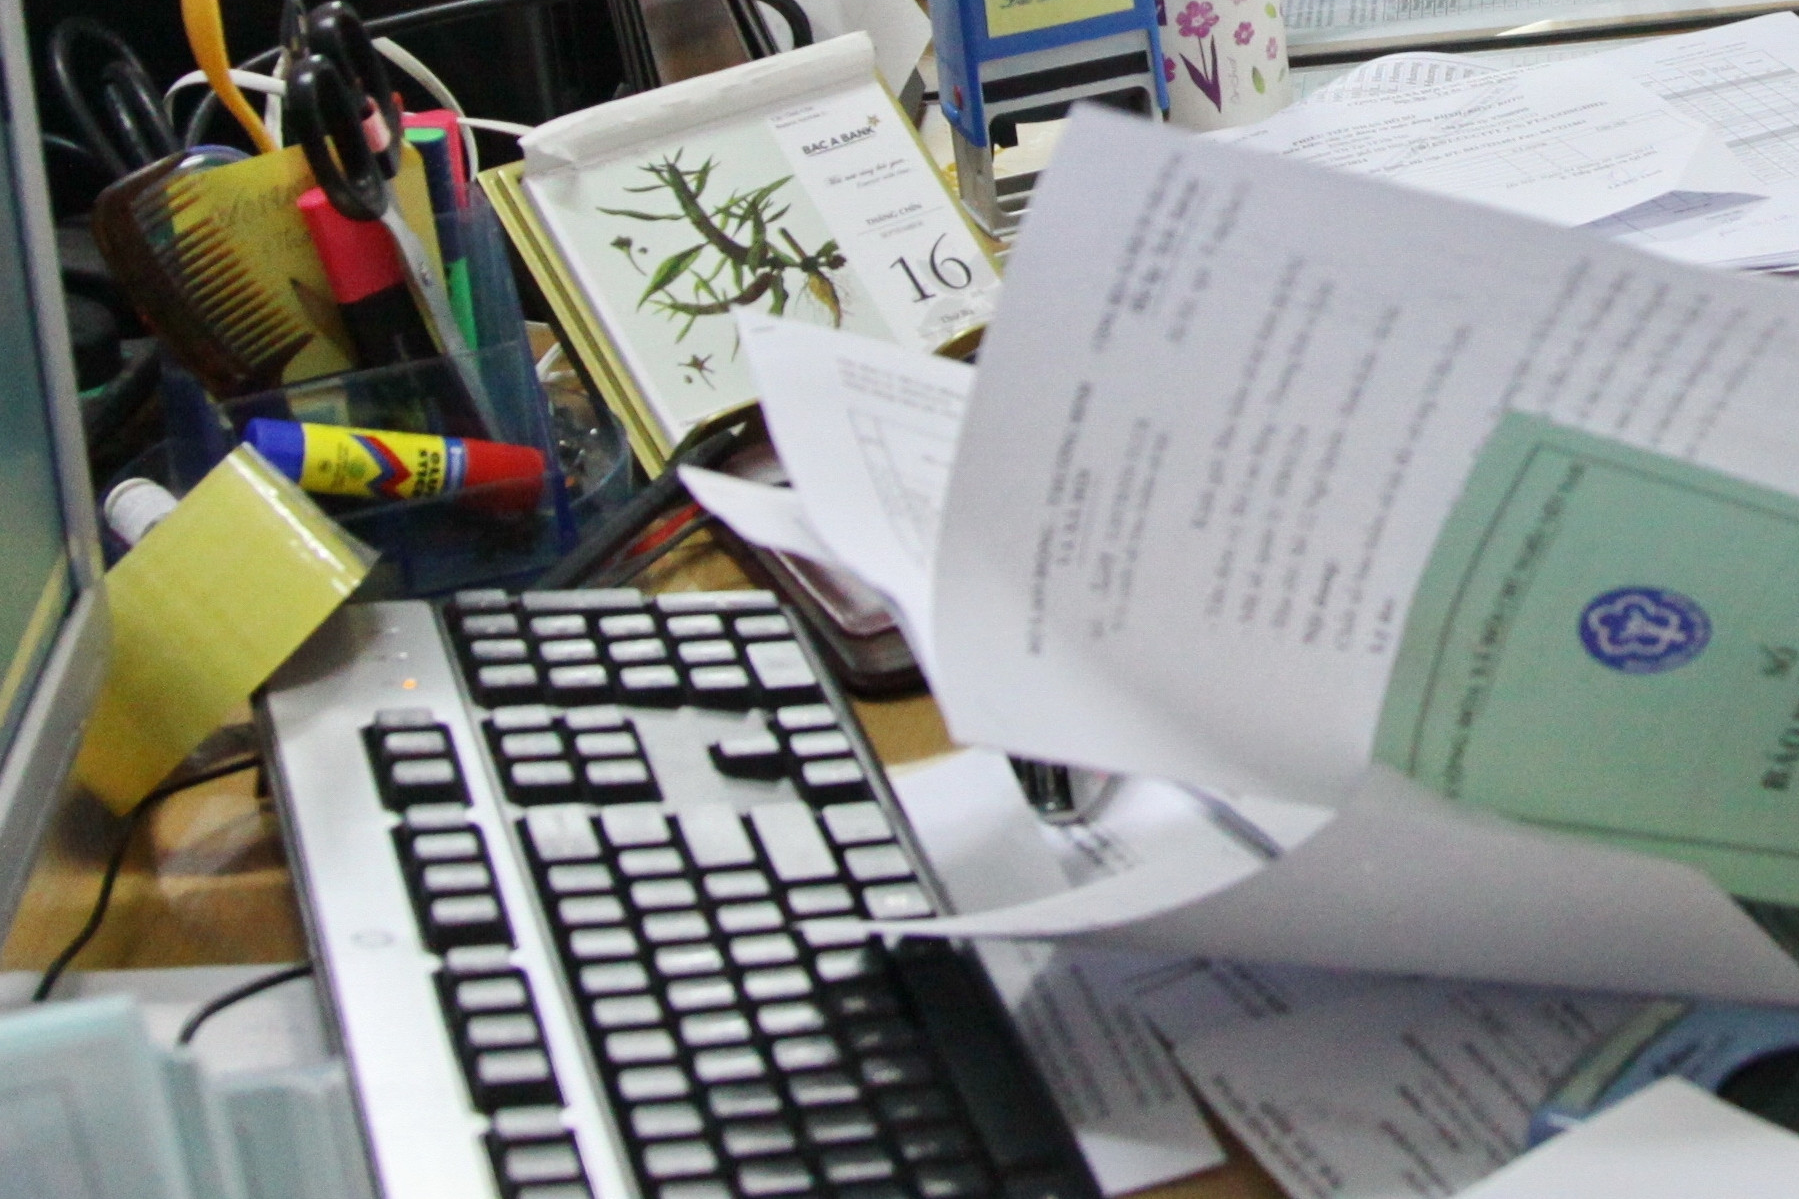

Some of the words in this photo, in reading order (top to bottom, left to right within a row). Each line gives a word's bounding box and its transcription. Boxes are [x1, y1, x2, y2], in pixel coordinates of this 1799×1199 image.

[802, 141, 828, 155] BAC
[830, 136, 840, 146] A
[842, 125, 876, 143] BANK
[889, 232, 972, 303] 16
